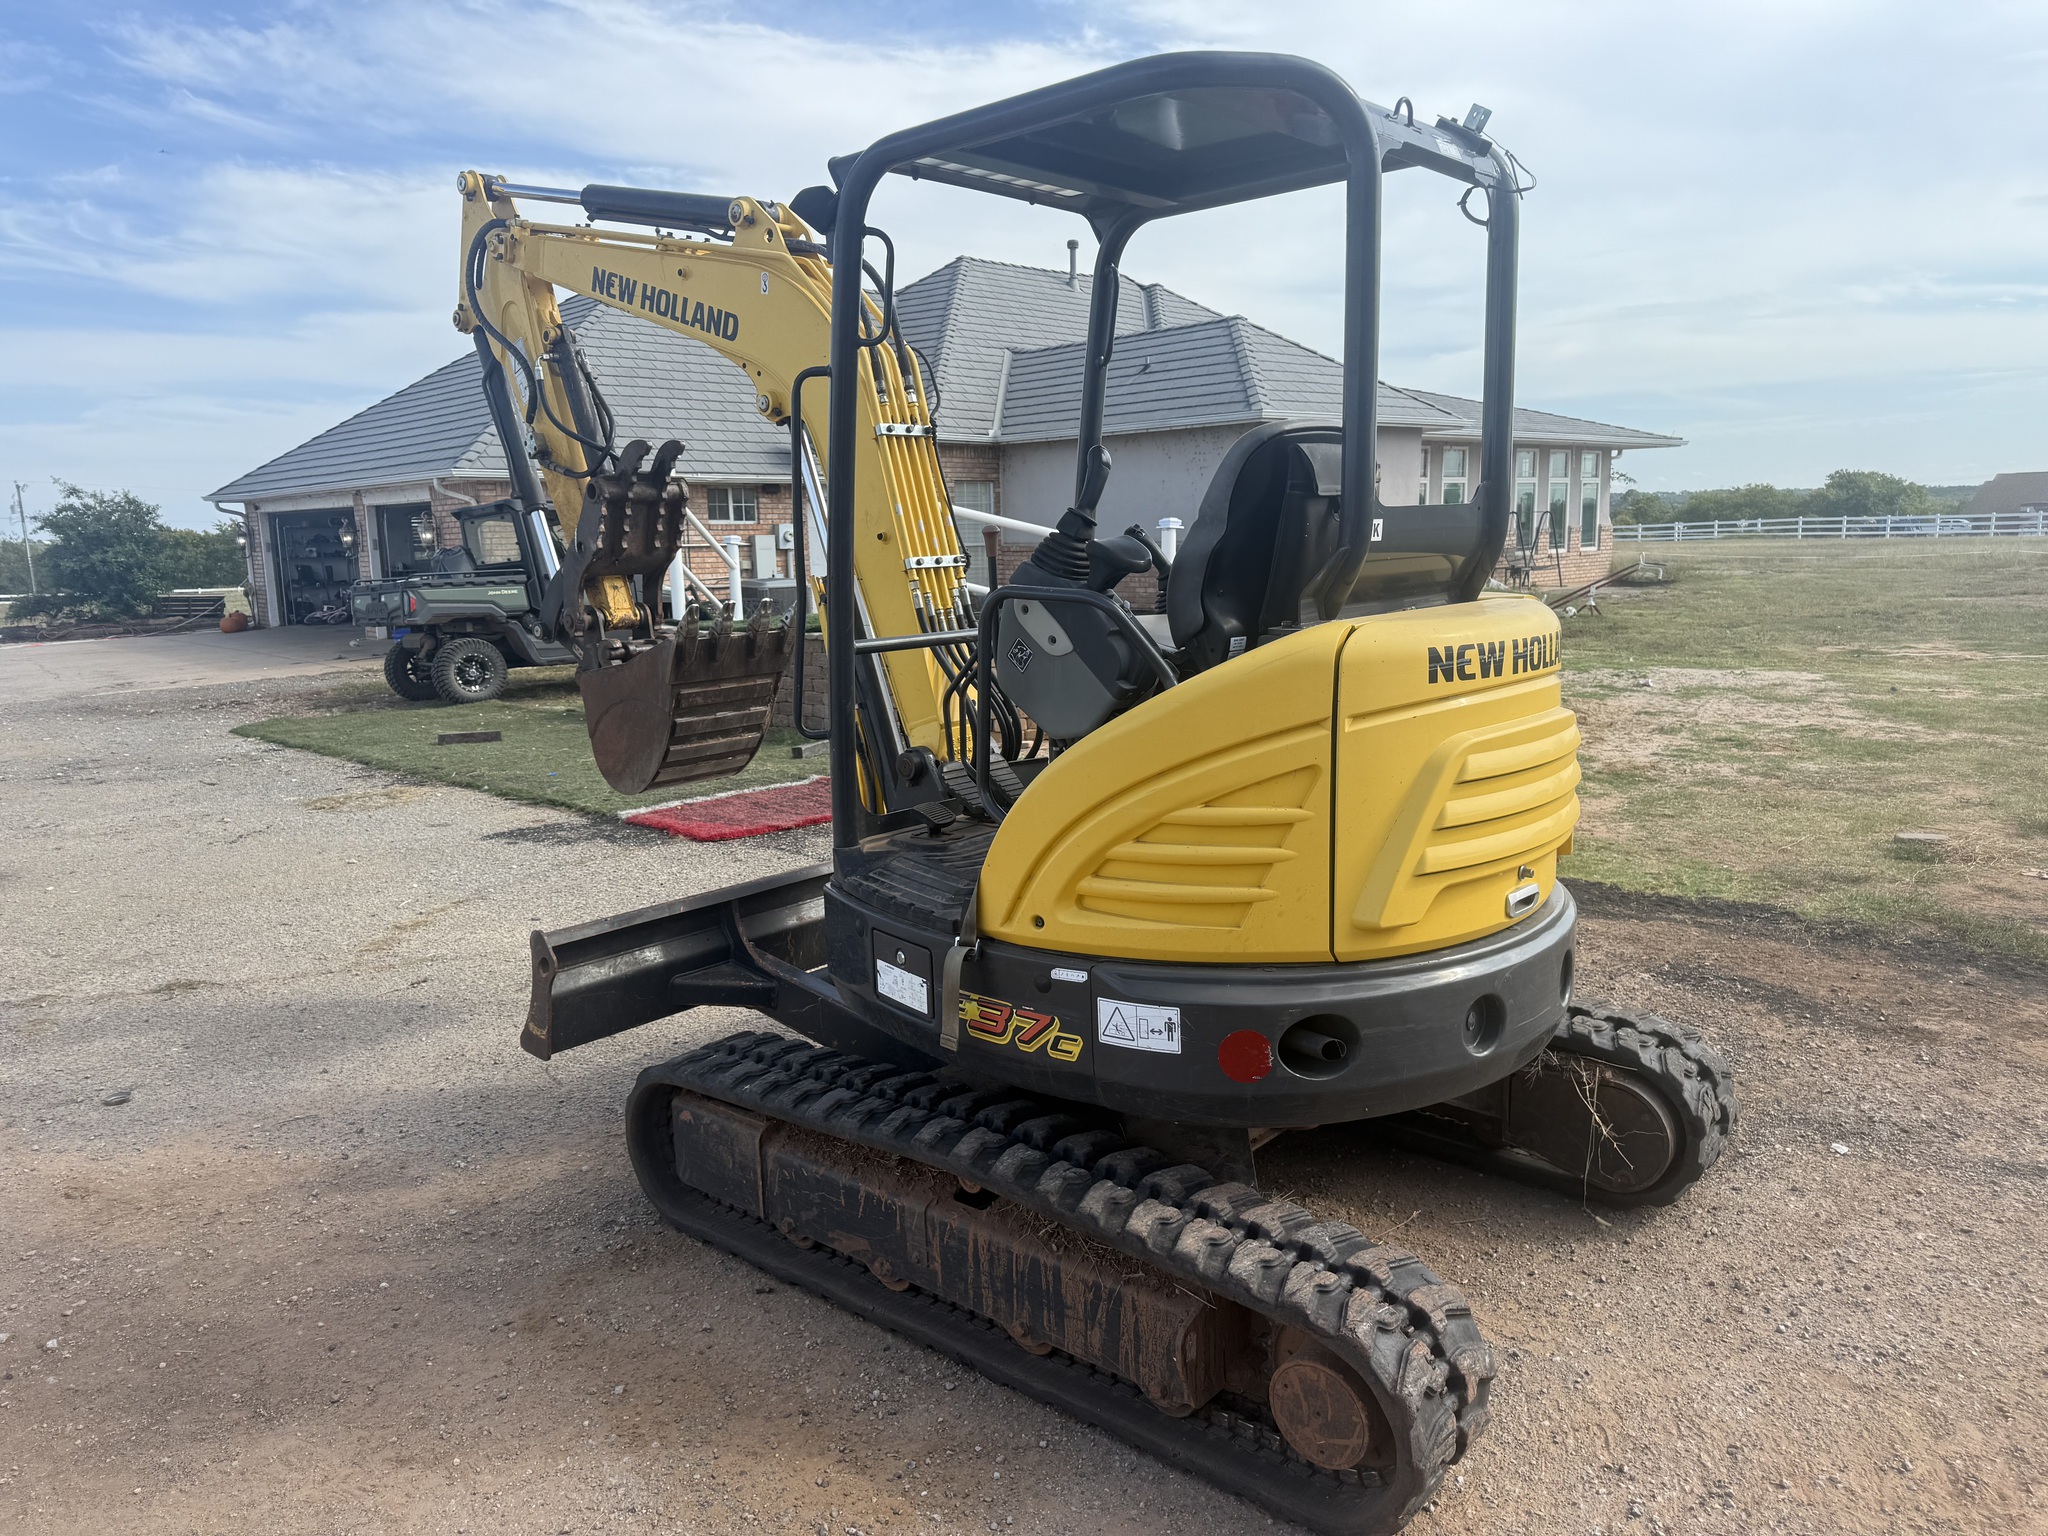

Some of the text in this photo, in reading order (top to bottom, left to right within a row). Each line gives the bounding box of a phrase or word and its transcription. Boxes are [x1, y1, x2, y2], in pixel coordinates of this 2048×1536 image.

[591, 266, 739, 342] NEW HOLLAND
[1428, 641, 1505, 685] NEW
